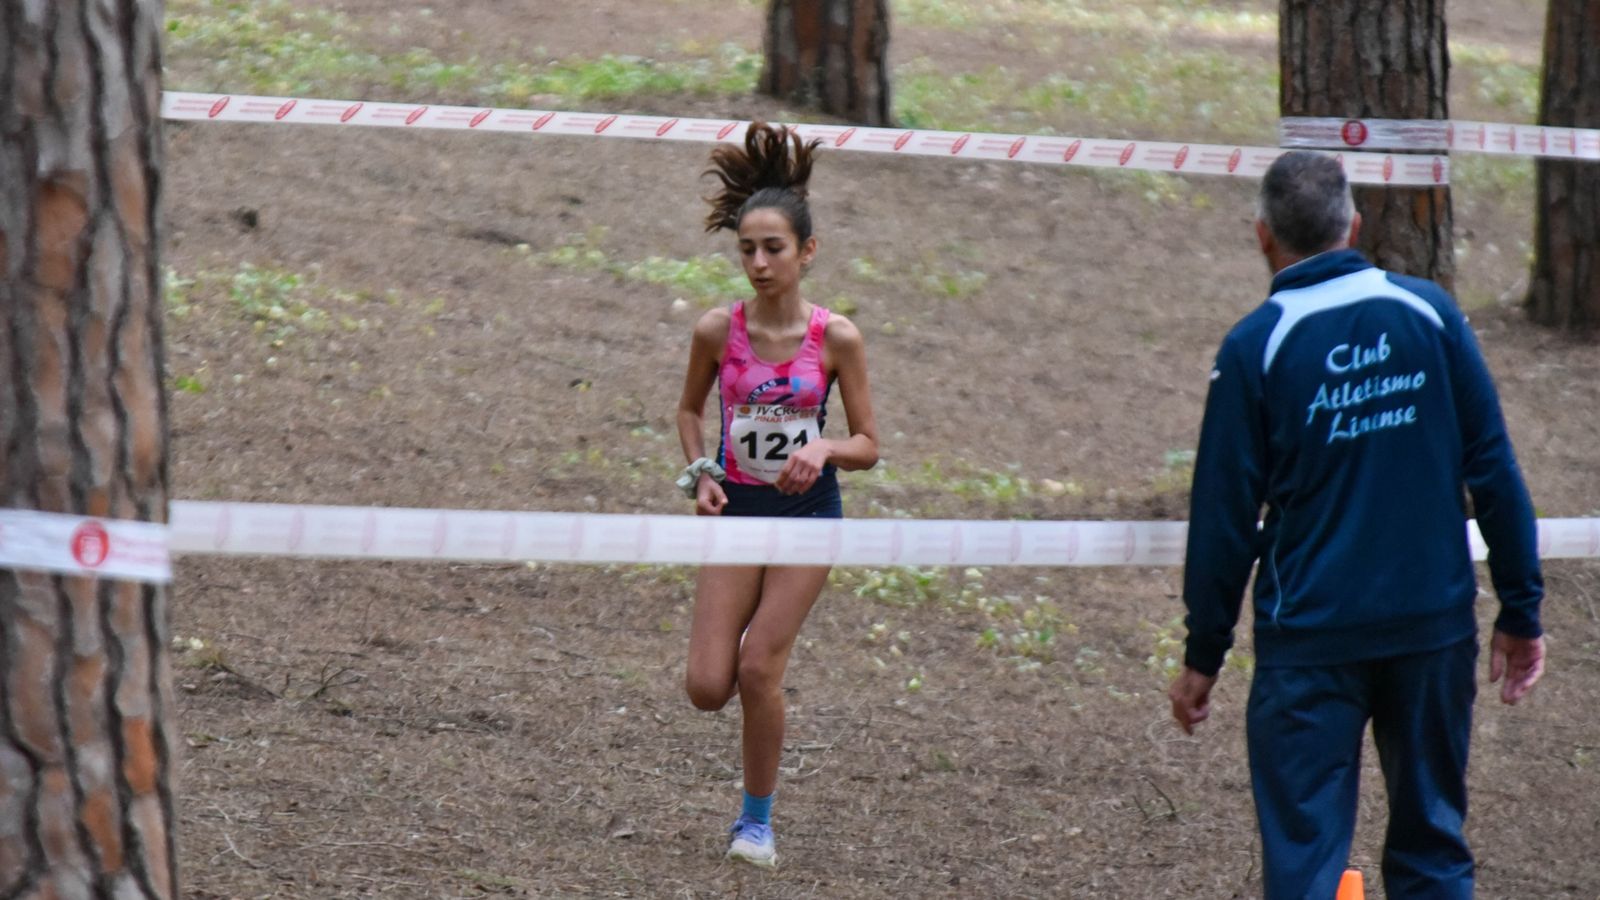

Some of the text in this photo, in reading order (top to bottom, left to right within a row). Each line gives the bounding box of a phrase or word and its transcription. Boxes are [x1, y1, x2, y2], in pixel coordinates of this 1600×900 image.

[1325, 332, 1391, 374] Club
[1306, 369, 1427, 426] Atletismo
[740, 429, 809, 461] 121
